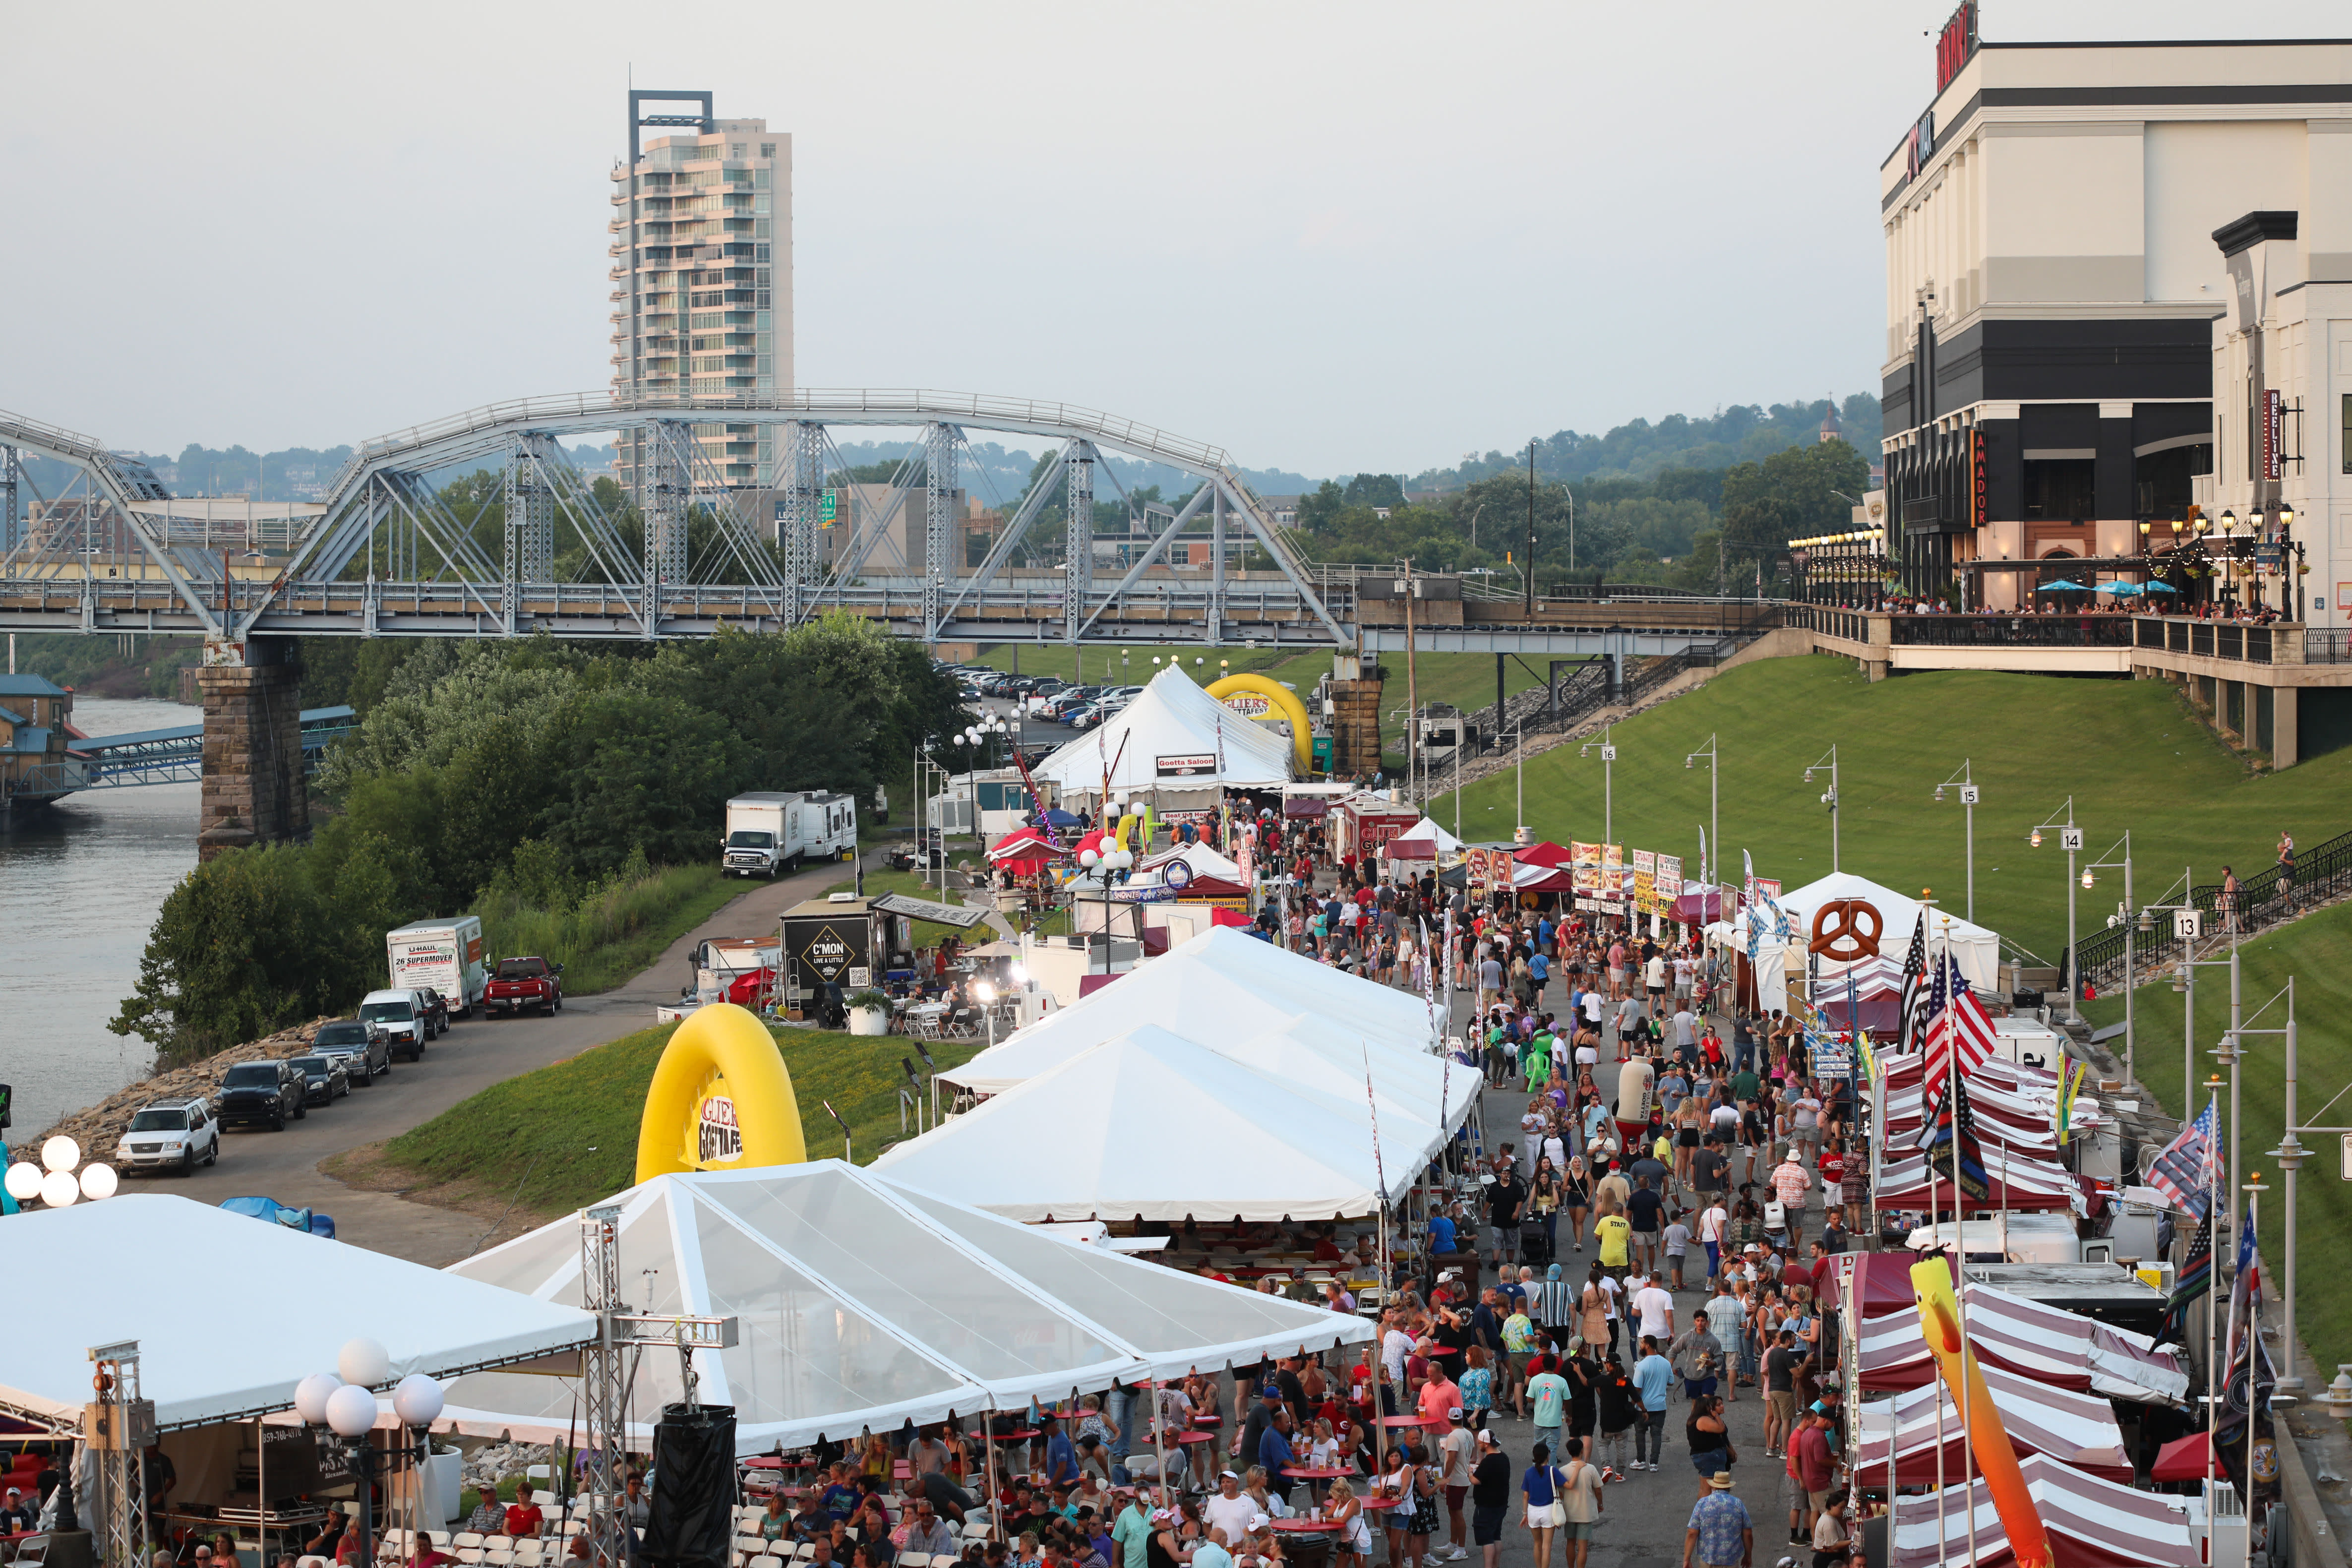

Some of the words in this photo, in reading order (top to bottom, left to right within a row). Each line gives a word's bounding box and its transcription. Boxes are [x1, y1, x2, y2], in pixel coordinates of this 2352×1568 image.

[1976, 434, 1986, 524] AMADOR
[1222, 698, 1269, 709] GLIER'S
[1605, 750, 1613, 759] 16
[1965, 791, 1975, 802] 15
[1362, 828, 1412, 839] GLIER'
[2065, 835, 2079, 847] 14
[1665, 857, 1680, 866] CHICKEN
[1659, 869, 1680, 877] TENDERLOIN
[1114, 891, 1140, 900] SNOWIE
[2180, 919, 2193, 935] 13
[813, 943, 844, 955] C'MON
[407, 955, 453, 964] SUPERMOVER
[263, 1428, 302, 1444] 859-760-4978
